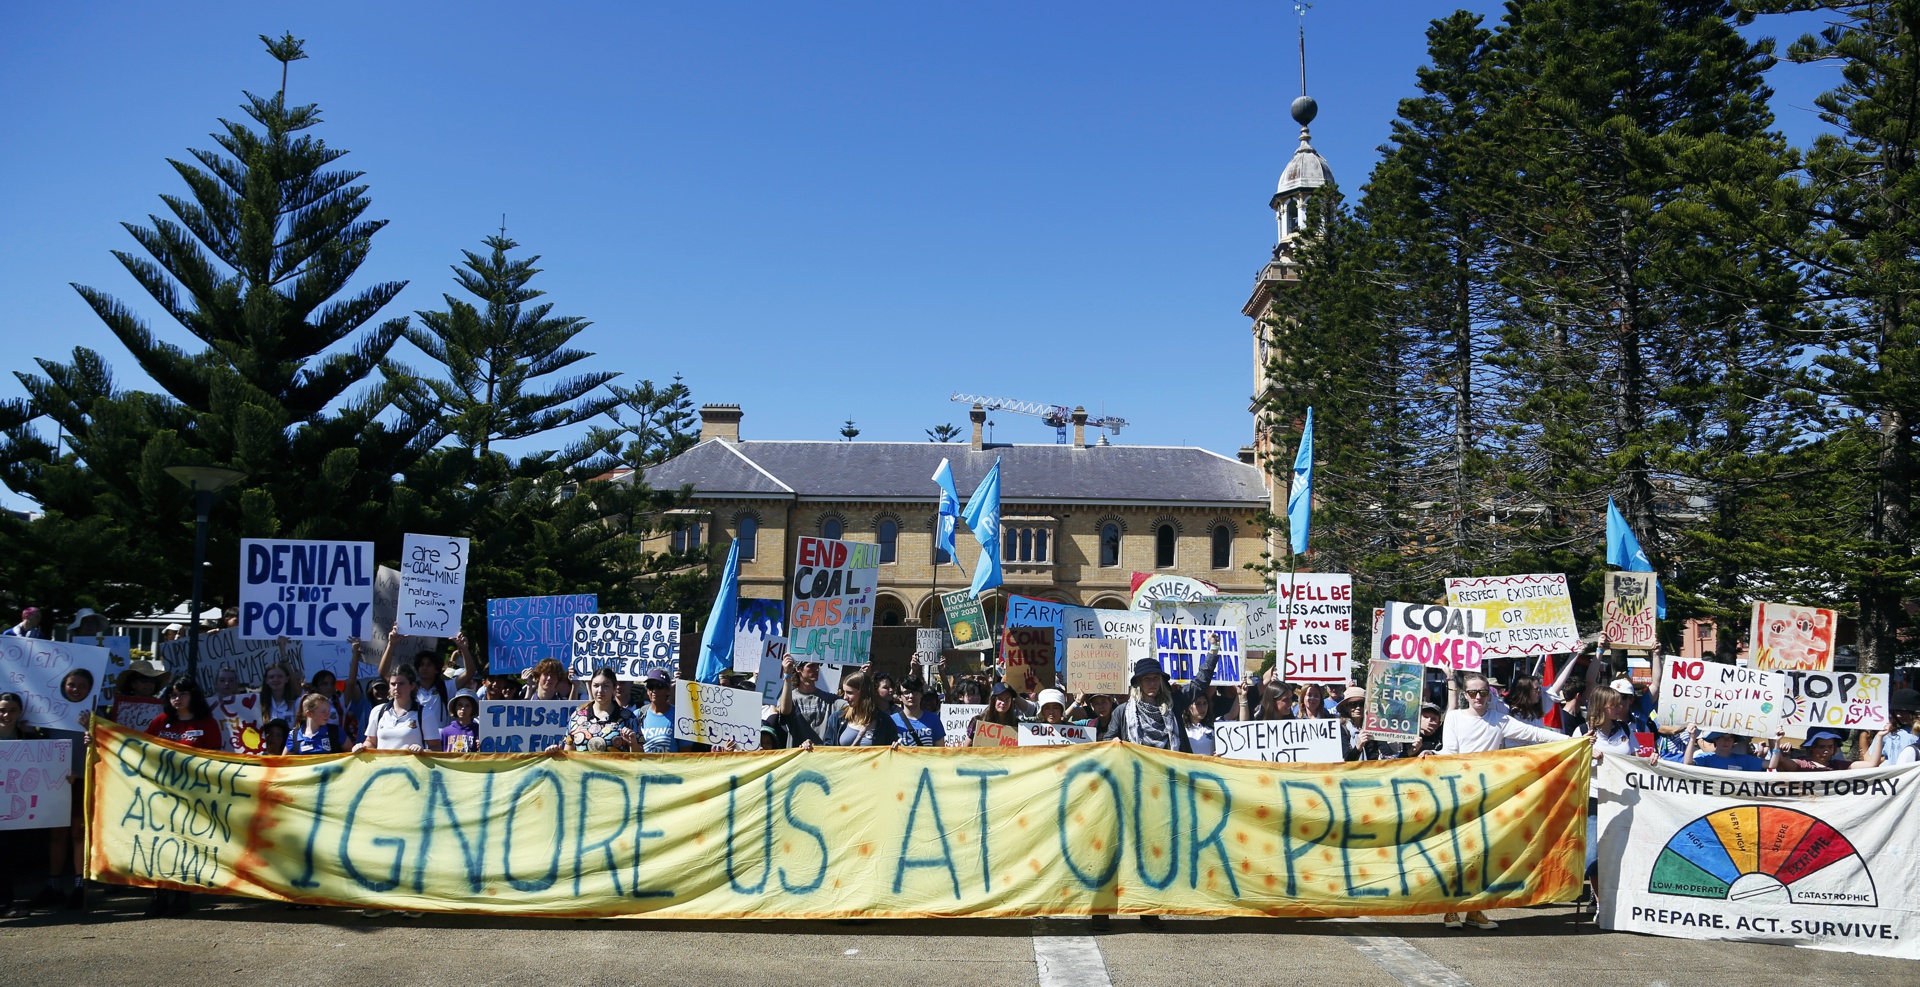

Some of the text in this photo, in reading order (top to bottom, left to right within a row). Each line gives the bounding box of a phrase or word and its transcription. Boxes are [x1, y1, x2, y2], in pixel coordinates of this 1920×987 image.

[412, 541, 461, 571] are 3
[799, 538, 878, 569] END ALL
[247, 544, 370, 586] DENIAL
[412, 561, 435, 576] COAL
[434, 570, 460, 585] MINE
[278, 586, 332, 603] IS NOT
[1331, 585, 1350, 600] BE
[1458, 584, 1563, 602] RESPECT EXISTENCE
[243, 602, 370, 637] POLICY
[791, 598, 842, 628] GAS
[961, 607, 978, 616] 2030
[1278, 604, 1351, 615] LESS ACTIVIST
[1502, 610, 1523, 623] OR
[1606, 600, 1652, 627] CLIMATE
[642, 615, 679, 630] DIE
[1074, 618, 1144, 634] THE OCEANS
[1279, 619, 1298, 630] IF
[1335, 619, 1350, 631] BE
[1403, 604, 1484, 638] COAL
[575, 630, 678, 643] OF OLD AGE
[1005, 630, 1051, 646] COAL
[1156, 628, 1197, 650] MAKE
[1300, 634, 1328, 645] LESS
[1508, 627, 1569, 643] RESISTANCE
[1605, 620, 1653, 645] CODE RED
[0, 640, 70, 668] olar
[617, 642, 649, 658] DIE
[653, 643, 680, 659] OF
[790, 628, 872, 663] LOGGING
[1073, 650, 1119, 660] SKIPPING
[1382, 633, 1483, 669] COOKED
[494, 646, 538, 670] HAVE
[572, 656, 628, 677] CLIMATE
[917, 651, 938, 663] FOOL
[1008, 649, 1049, 666] KILLS
[1087, 661, 1122, 670] LESSONS
[1285, 652, 1347, 675] SHIT
[1086, 672, 1119, 680] TEACH
[1372, 674, 1403, 686] NET
[1672, 661, 1768, 687] NO MORE
[1371, 688, 1415, 702] ZERO
[1673, 684, 1773, 701] DESTROYING
[1775, 670, 1858, 704] TOP
[487, 705, 546, 727] THIS
[949, 707, 969, 715] WHEN
[1370, 703, 1391, 714] BY
[1809, 701, 1864, 725] NOW
[1849, 705, 1885, 722] GAS
[1368, 718, 1410, 732] 2030
[1684, 707, 1768, 733] FUTURES
[977, 723, 1004, 739] ACT
[1031, 725, 1087, 740] OUR GOAL
[1216, 720, 1337, 756] SYSTEM CHANGE
[118, 738, 256, 798] CLIMATE
[0, 768, 71, 793] ROW
[1625, 771, 1900, 797] CLIMATE DANGER TODAY
[121, 787, 232, 842] ACTION
[290, 759, 1527, 900] IGNORE US AT OUR PERIL
[1729, 811, 1746, 852] VERY HIGH
[1772, 823, 1789, 852] SEVERE
[1686, 831, 1705, 850] HIGH
[1787, 835, 1831, 877] EXTREME
[1652, 881, 1724, 895] LOW-MODERATE
[1797, 890, 1870, 902] CATASTROPHIC
[1632, 907, 1899, 940] PREPARE. ACT. SURVIVE.
